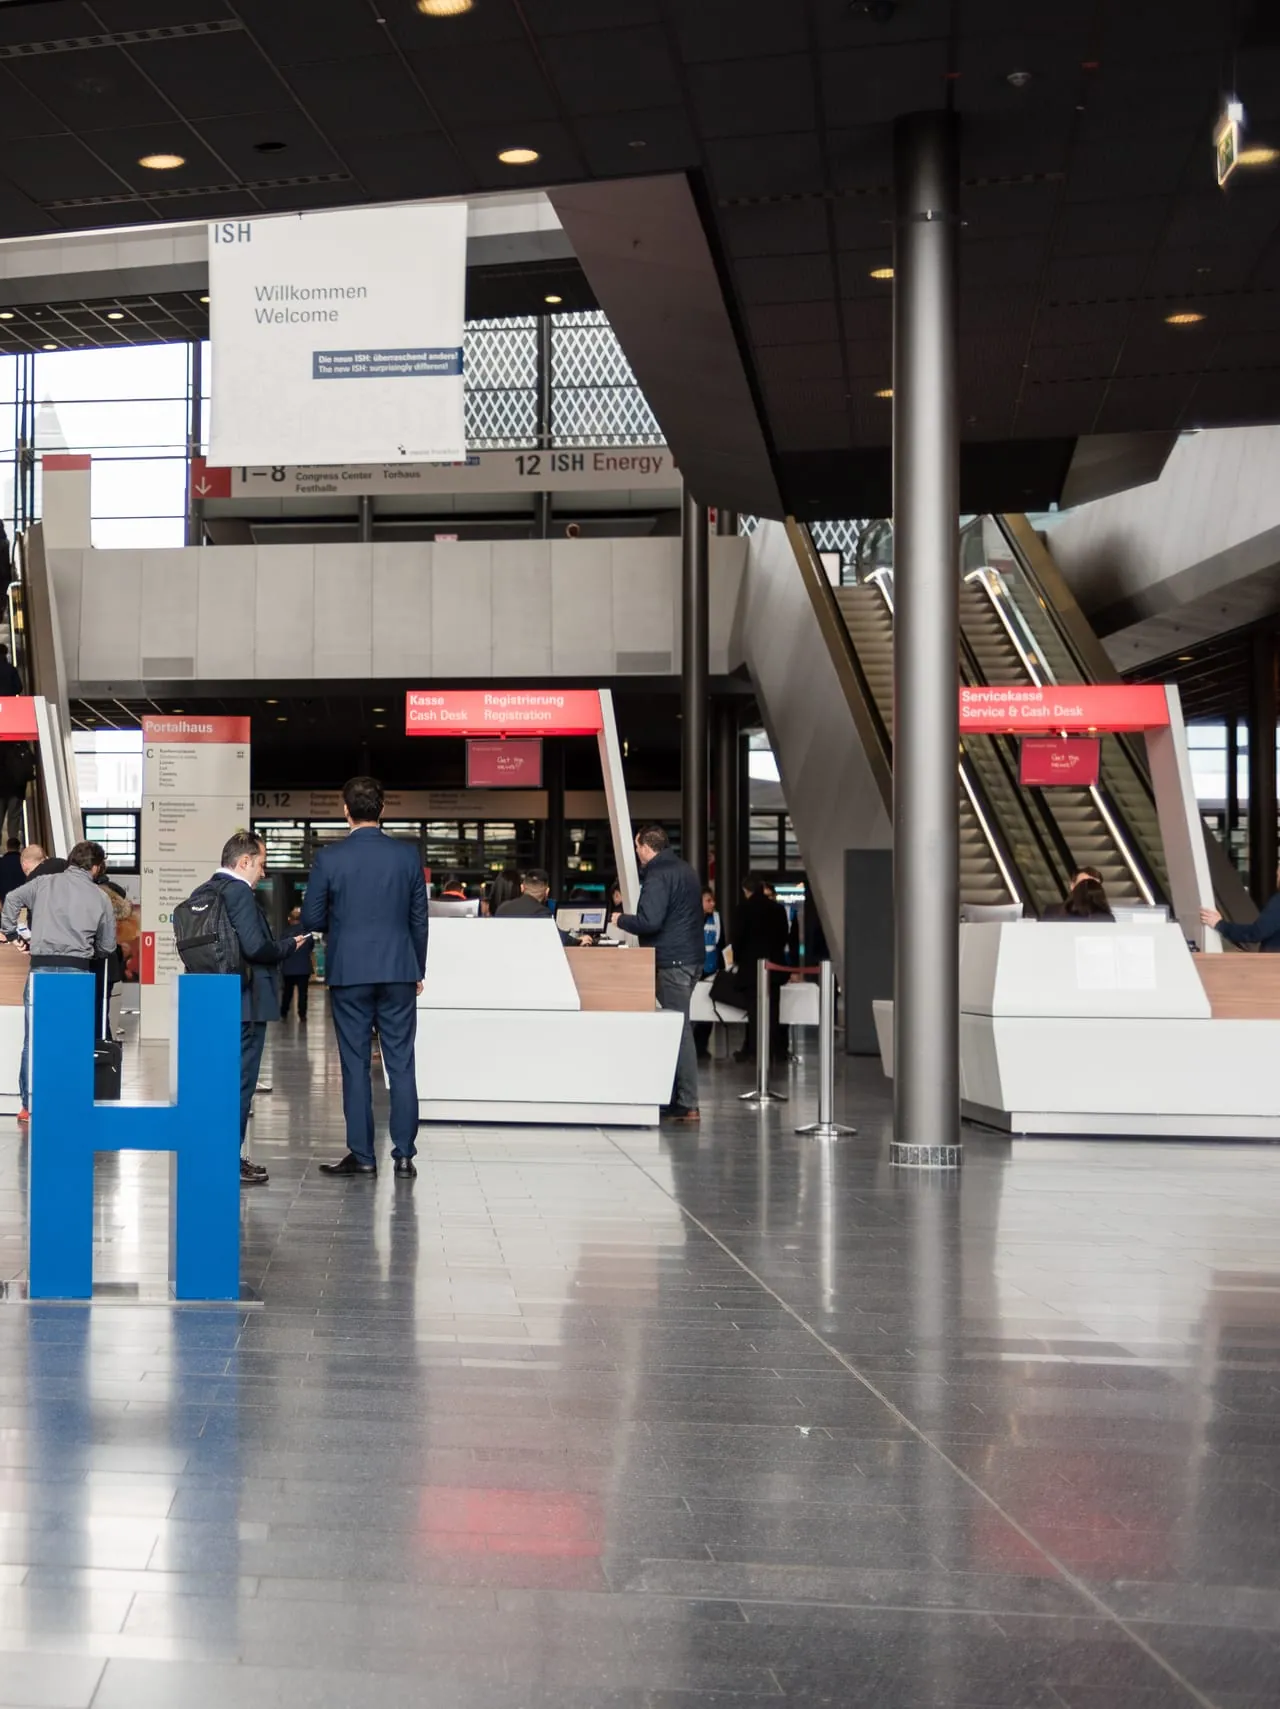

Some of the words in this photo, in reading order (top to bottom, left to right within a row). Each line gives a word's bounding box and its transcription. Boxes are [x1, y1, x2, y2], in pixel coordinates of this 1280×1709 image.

[214, 223, 252, 243] ISH
[255, 284, 368, 302] Willkommen
[255, 307, 339, 324] Welcome
[515, 455, 541, 476] 12
[551, 453, 584, 472] ISH
[593, 452, 663, 474] Energy
[295, 472, 339, 482] Congress
[341, 471, 372, 480] Center
[383, 470, 421, 479] Torhaus
[295, 484, 337, 493] Festhalle
[410, 695, 444, 706] Kasse
[484, 694, 564, 708] Registrierung
[962, 690, 1043, 702] Servicekasse
[410, 709, 437, 720] Cash
[440, 709, 468, 720] Desk
[484, 709, 551, 723] Registration
[962, 706, 1005, 718] Service
[1008, 706, 1018, 717] &
[1021, 705, 1050, 717] Cash
[1054, 705, 1084, 717] Desk
[145, 720, 213, 734] Portalhaus
[146, 748, 154, 759] C
[150, 801, 155, 811] 1
[274, 793, 291, 808] 12
[143, 867, 154, 875] Via
[144, 936, 152, 946] 0
